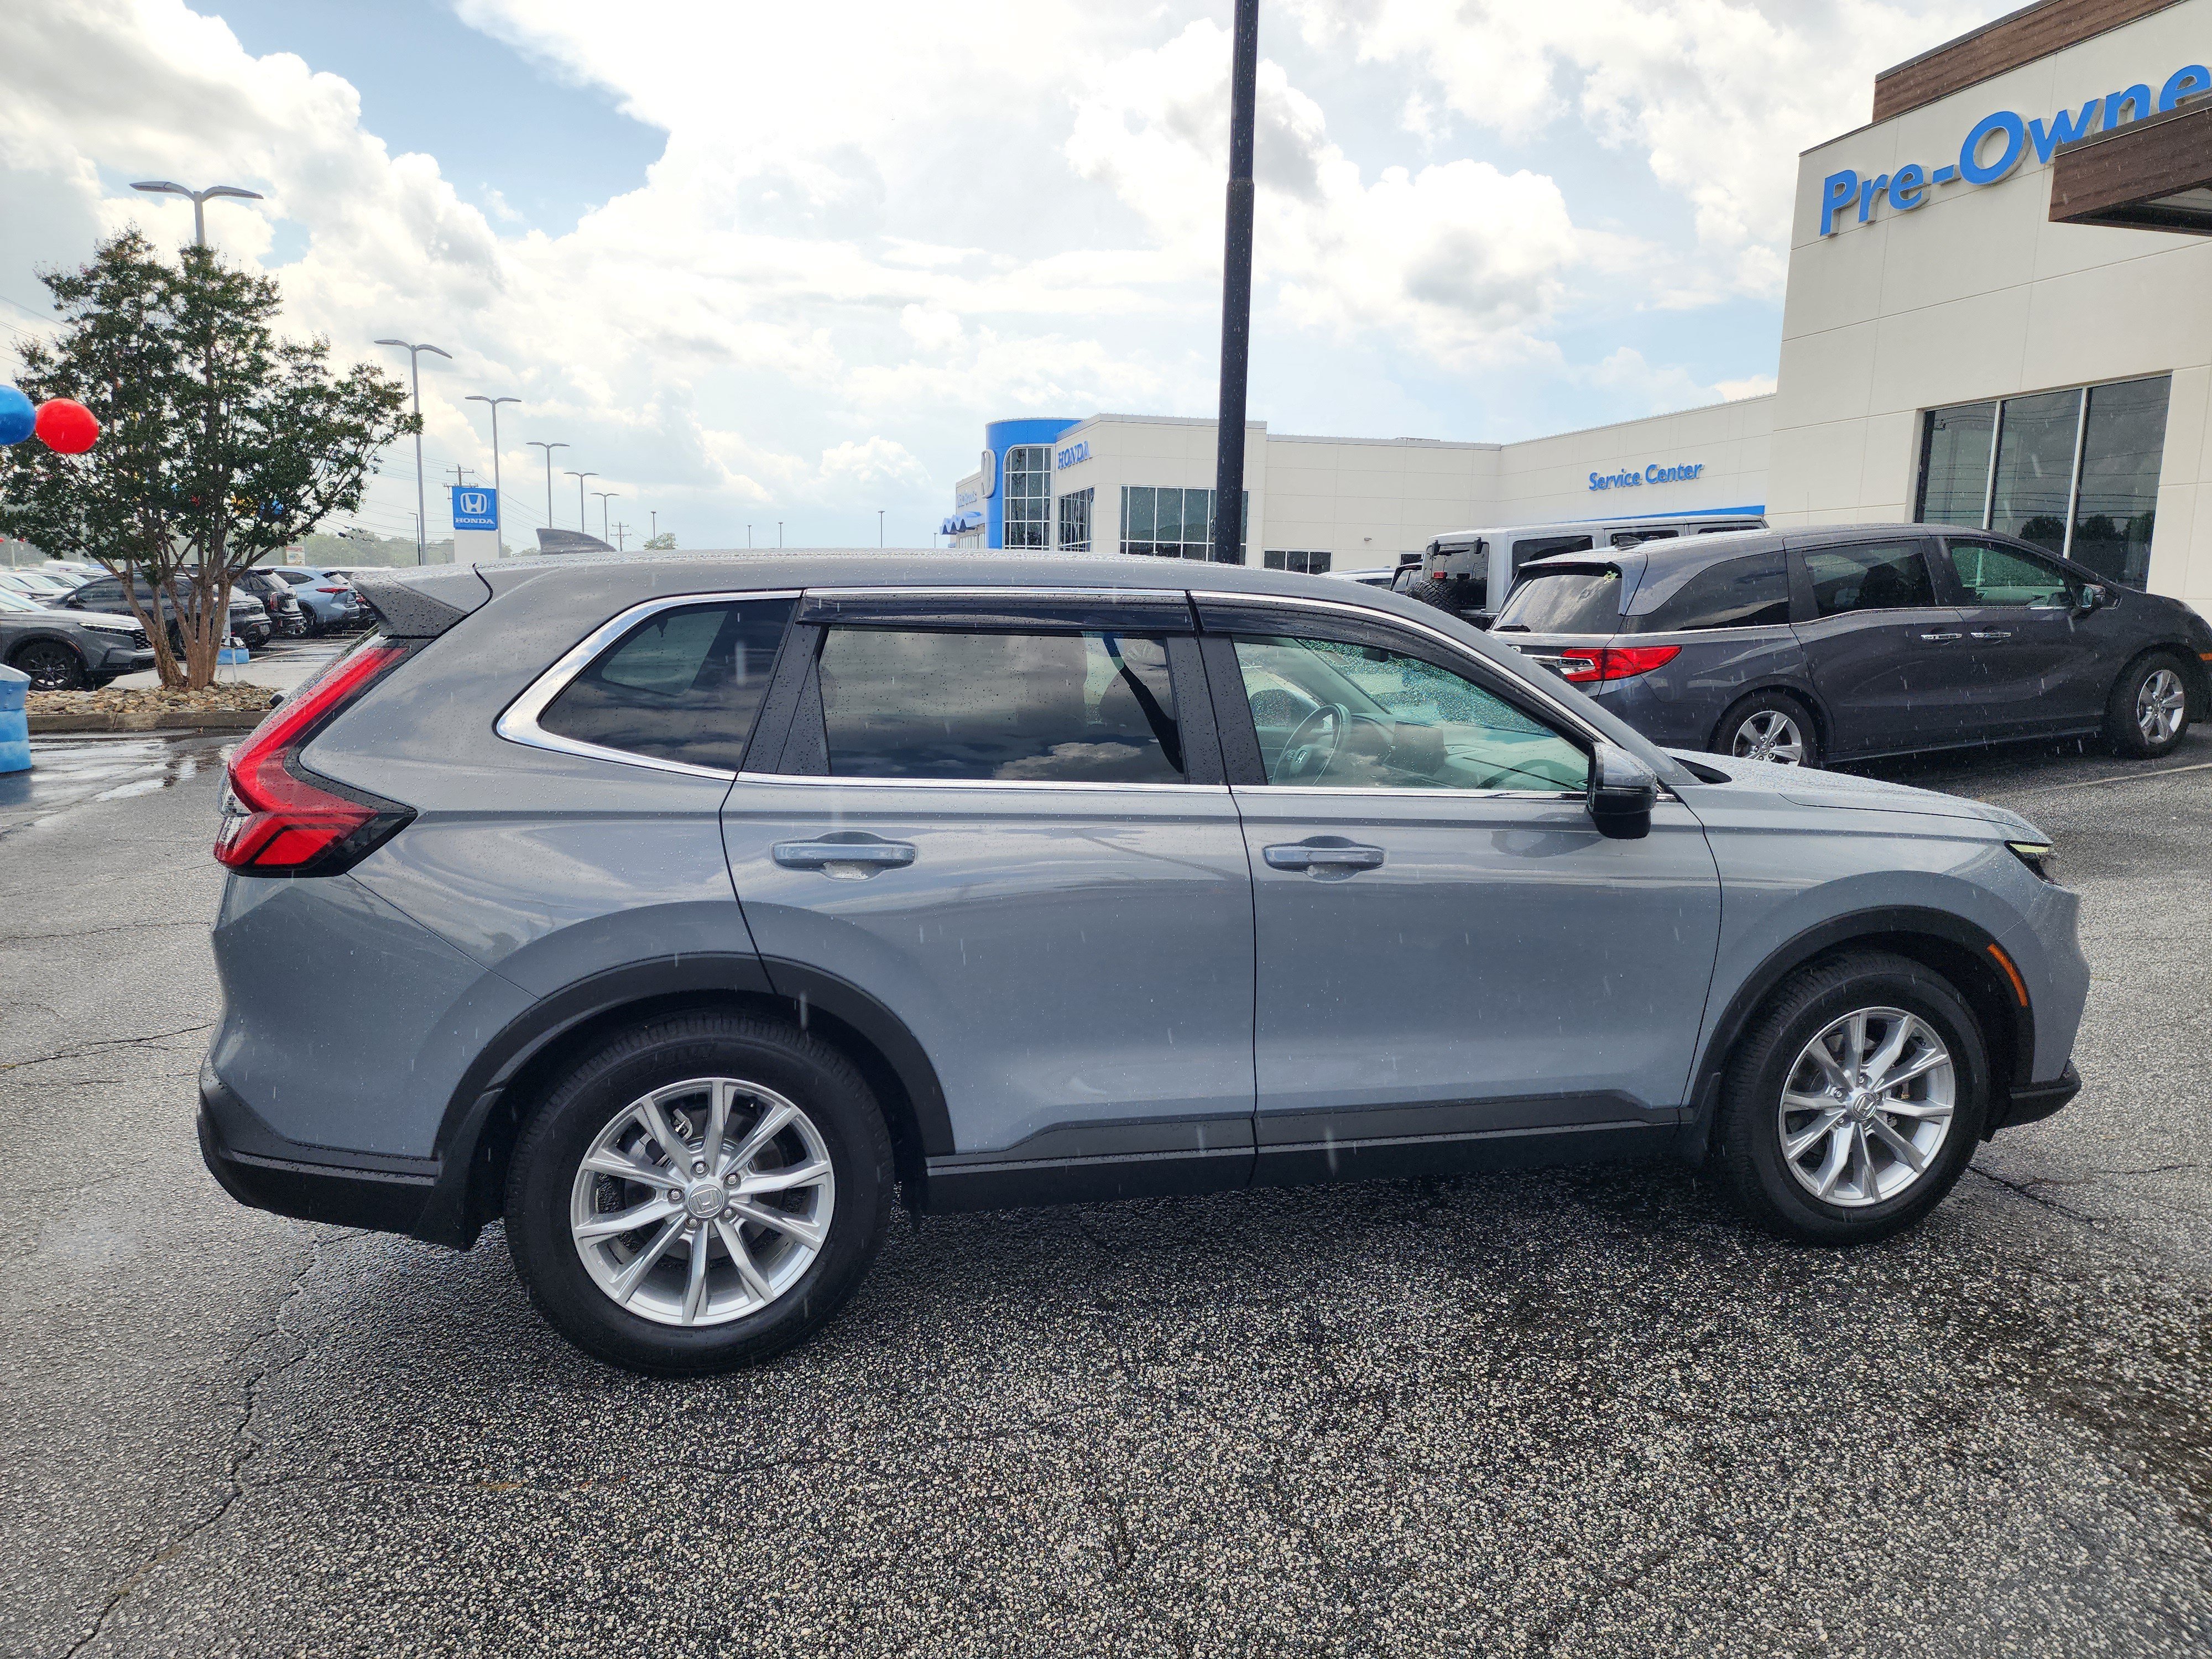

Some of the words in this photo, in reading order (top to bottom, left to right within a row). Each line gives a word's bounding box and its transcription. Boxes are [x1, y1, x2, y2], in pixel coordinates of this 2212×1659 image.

[1057, 440, 1091, 469] HONDA
[1588, 468, 1642, 491] Service
[1645, 463, 1704, 484] Center
